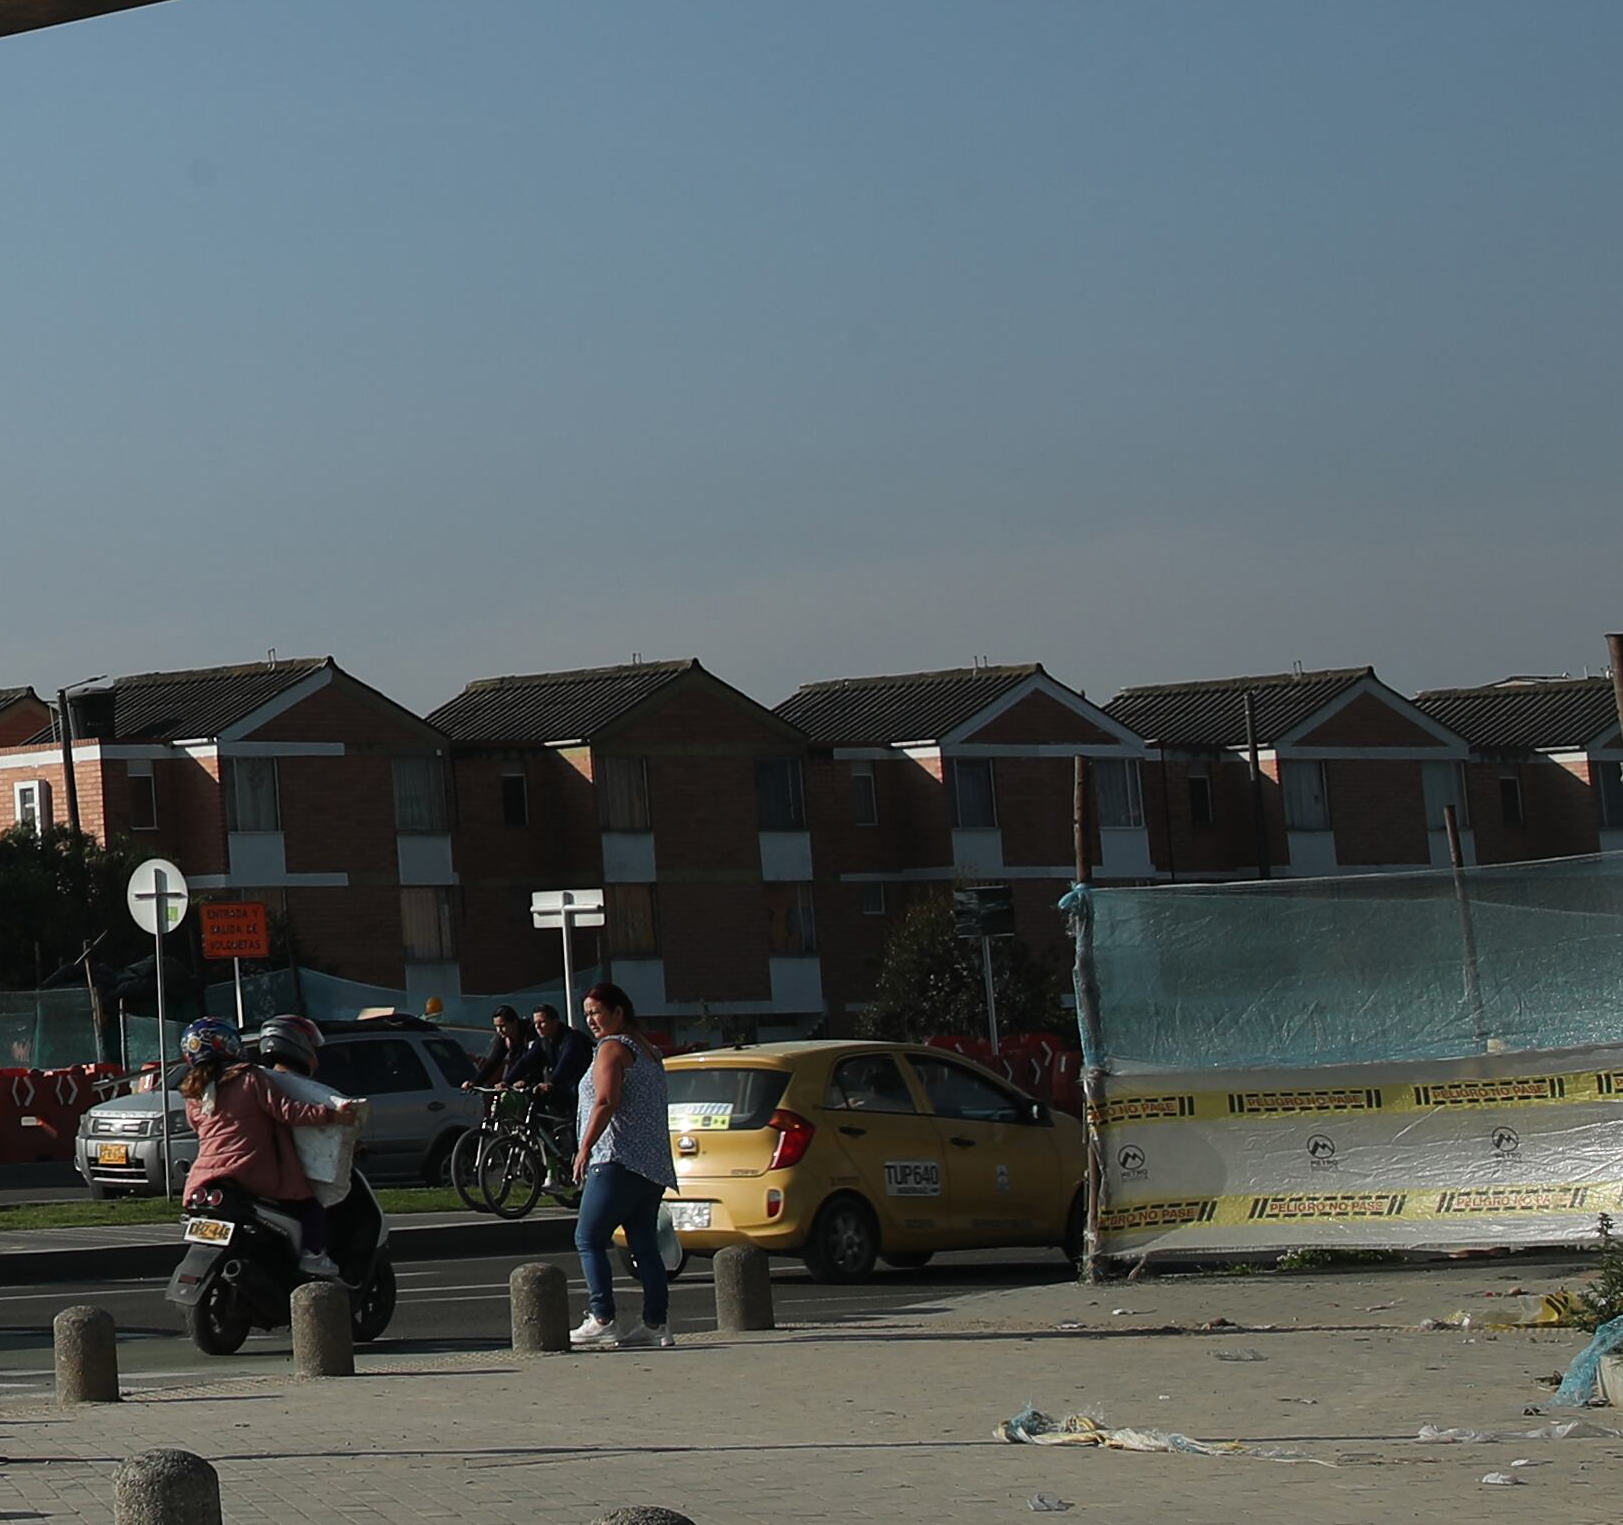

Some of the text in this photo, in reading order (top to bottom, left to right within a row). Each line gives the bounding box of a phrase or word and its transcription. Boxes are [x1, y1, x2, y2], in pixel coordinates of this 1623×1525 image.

[207, 909, 249, 919] ENTRADA
[209, 924, 242, 935] SALIDA
[1432, 1084, 1546, 1099] PELIGRO NO PASE
[1247, 1094, 1363, 1107] PELIGRO NO PASE
[1119, 1104, 1139, 1115] NO
[1141, 1102, 1175, 1113] PASE
[884, 1165, 939, 1185] TUP640
[1269, 1200, 1384, 1213] PELIGRO NO PASE
[1139, 1210, 1159, 1221] NO
[1161, 1208, 1195, 1219] PASE
